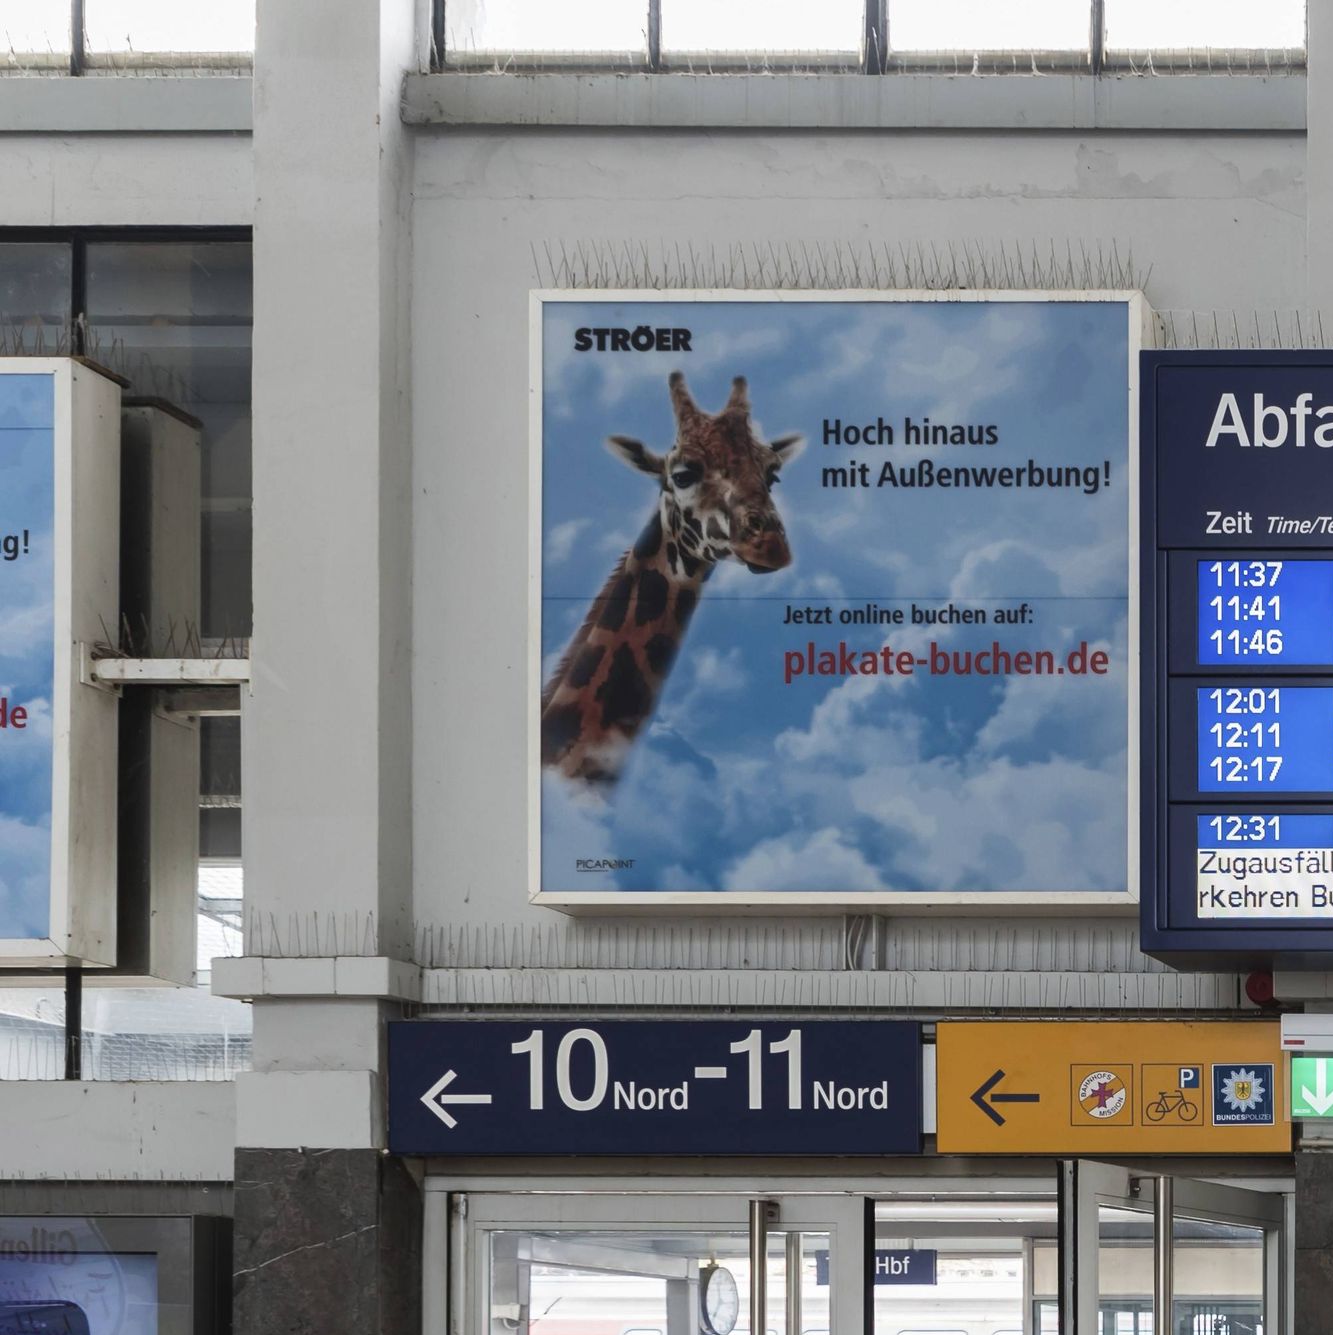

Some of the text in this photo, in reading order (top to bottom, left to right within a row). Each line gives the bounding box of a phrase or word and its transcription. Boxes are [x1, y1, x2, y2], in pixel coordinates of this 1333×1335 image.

[574, 325, 692, 352] STRÖER
[822, 418, 998, 446] Hoch hinaus
[822, 459, 1111, 494] mit Außenwerbung!
[1206, 511, 1252, 534] Zeit
[0, 529, 29, 561] g!
[1210, 562, 1282, 587] 11:37
[783, 604, 1034, 628] Jetzt online buchen auf:
[1210, 596, 1280, 621] 11:41
[1210, 630, 1283, 654] 11:46
[783, 642, 1109, 683] plakate-buchen.de
[1210, 689, 1280, 714] 12:01
[1210, 722, 1280, 747] 12:11
[1210, 756, 1283, 781] 12:17
[1210, 816, 1281, 841] 12:31
[511, 1028, 609, 1111] 10
[613, 1081, 688, 1110] Nord
[813, 1081, 888, 1110] Nord
[1180, 1069, 1194, 1088] P
[1080, 1073, 1112, 1098] BAHNHOFS
[1098, 1096, 1124, 1117] MISSION
[875, 1256, 910, 1275] Hbf
